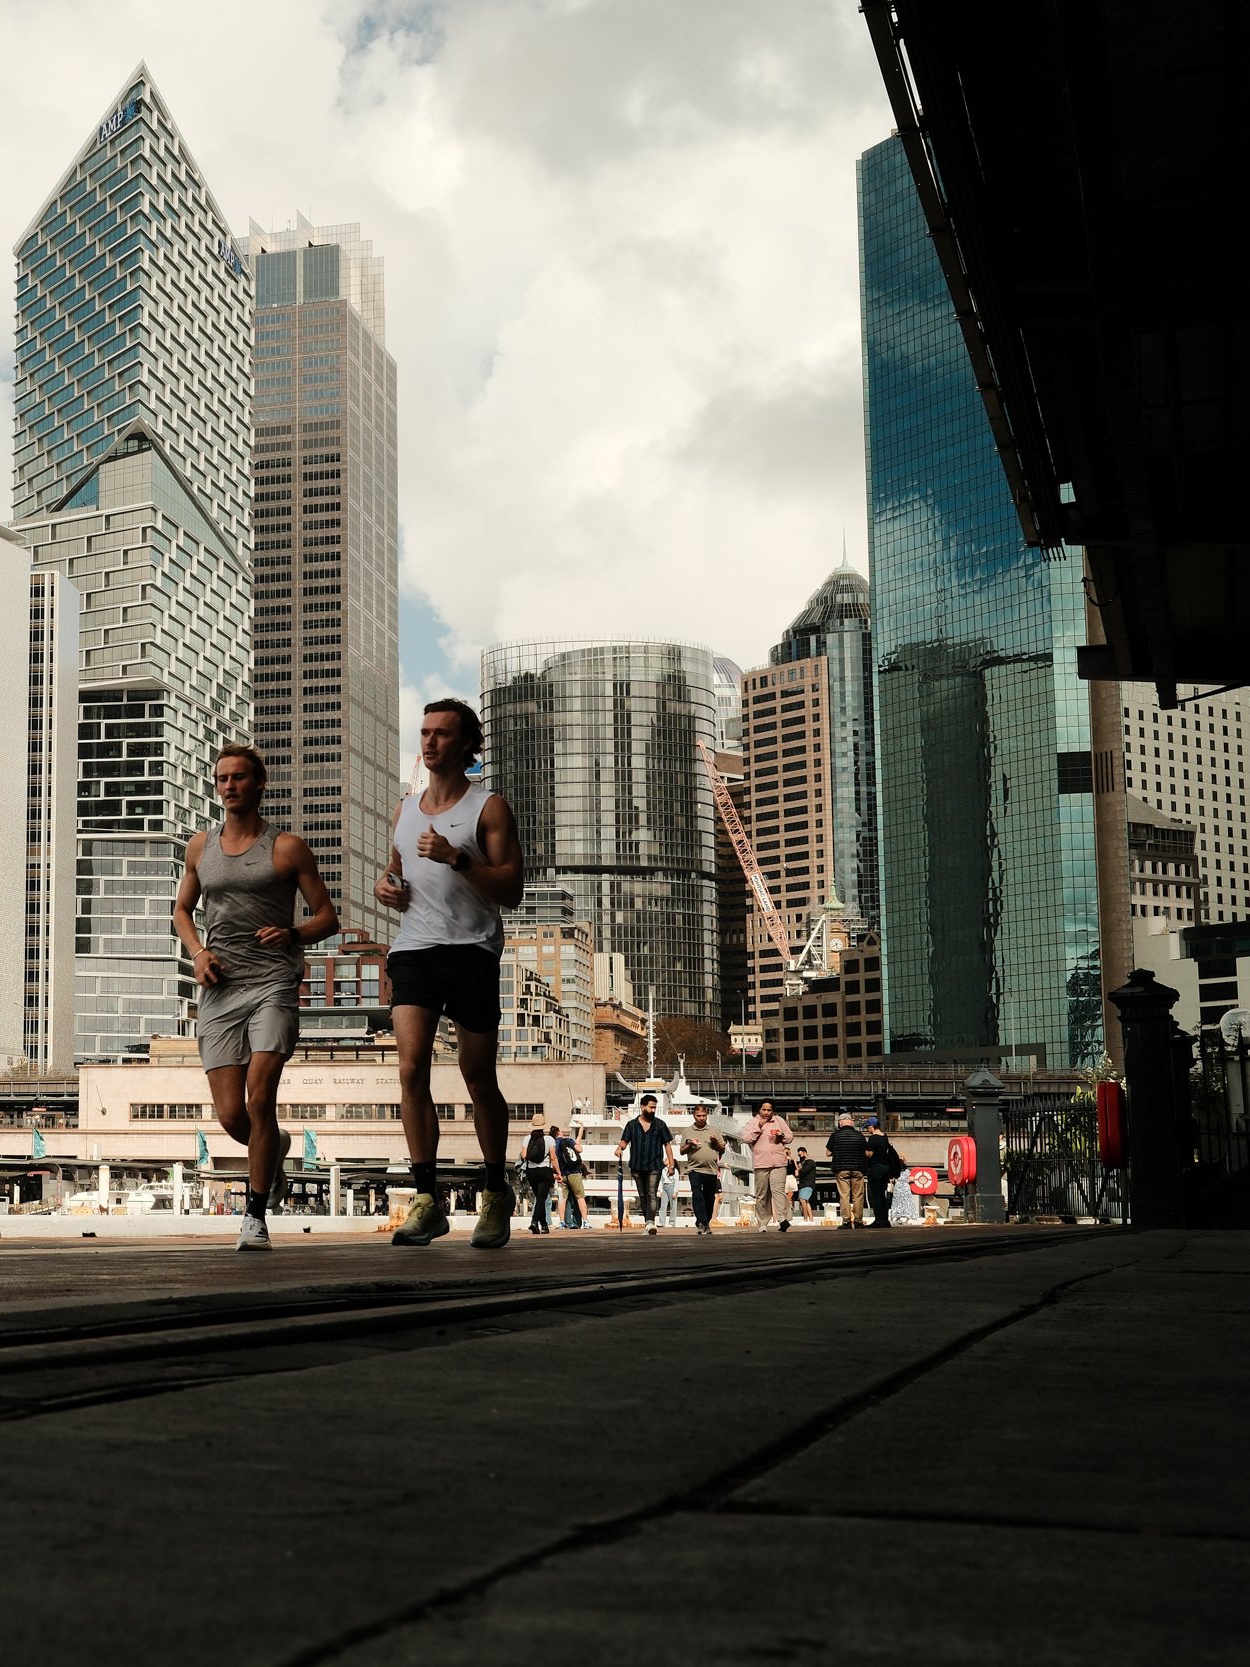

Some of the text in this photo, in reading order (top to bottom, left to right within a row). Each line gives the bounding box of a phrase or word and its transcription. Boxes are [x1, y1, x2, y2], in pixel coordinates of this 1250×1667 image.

[100, 111, 124, 142] AMP
[220, 241, 235, 267] AMP
[753, 875, 771, 912] PONTIAC LAND
